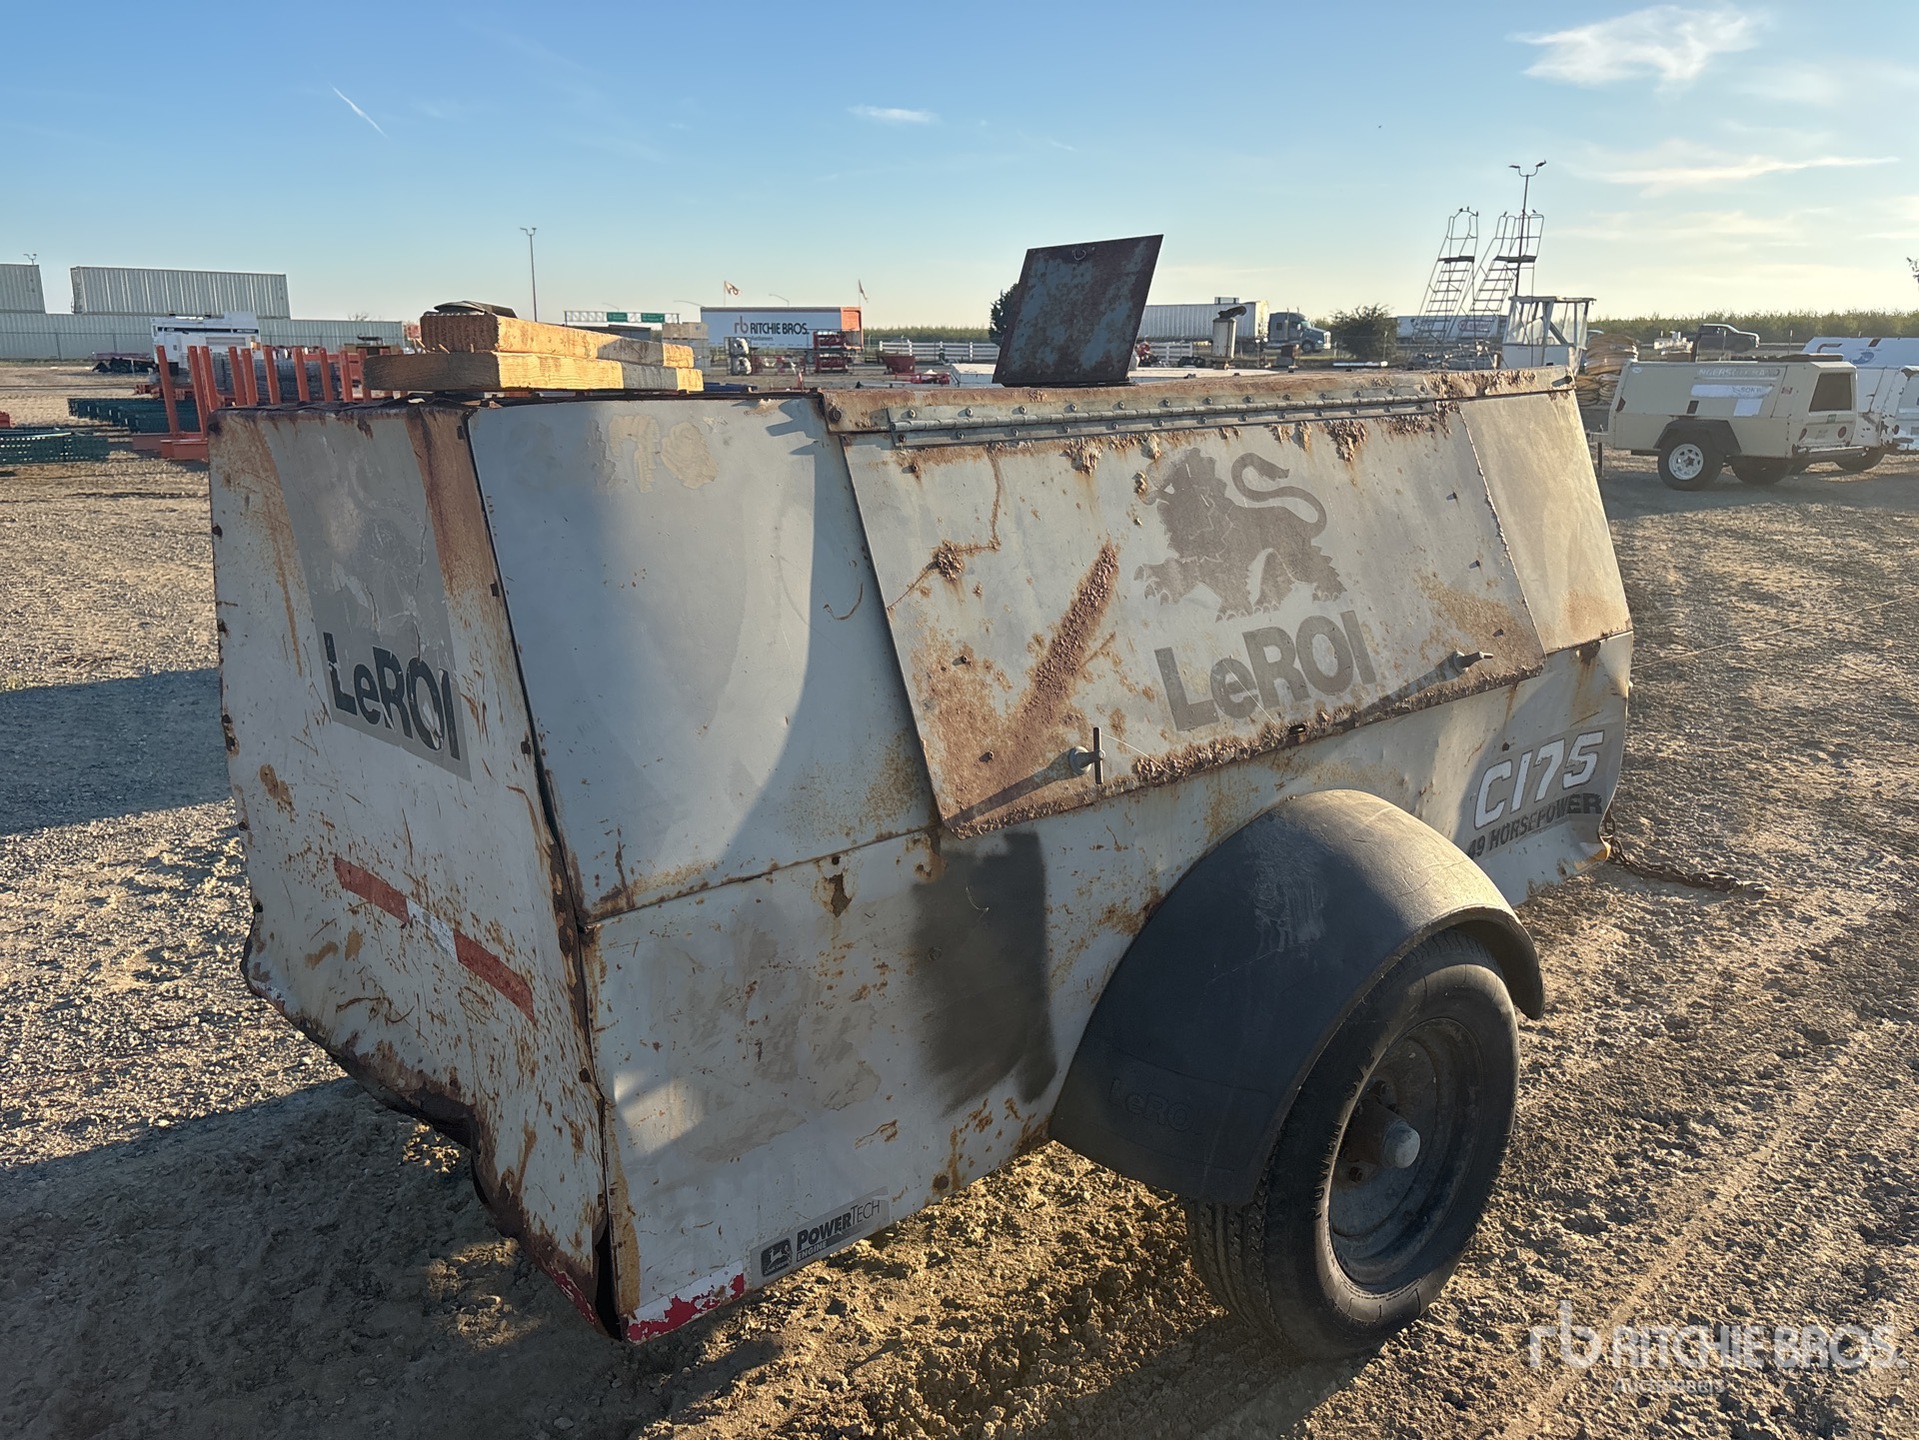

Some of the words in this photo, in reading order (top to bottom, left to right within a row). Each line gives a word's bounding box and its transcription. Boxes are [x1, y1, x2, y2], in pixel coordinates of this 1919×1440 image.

[734, 316, 749, 334] rb
[750, 323, 781, 334] RITCHIE
[782, 323, 810, 335] BROS.
[323, 631, 461, 761] LeROI
[1154, 609, 1377, 732] LeROI
[1474, 730, 1605, 830] C175
[1489, 792, 1602, 851] HORSEPOWER
[798, 1240, 828, 1260] ENGINE
